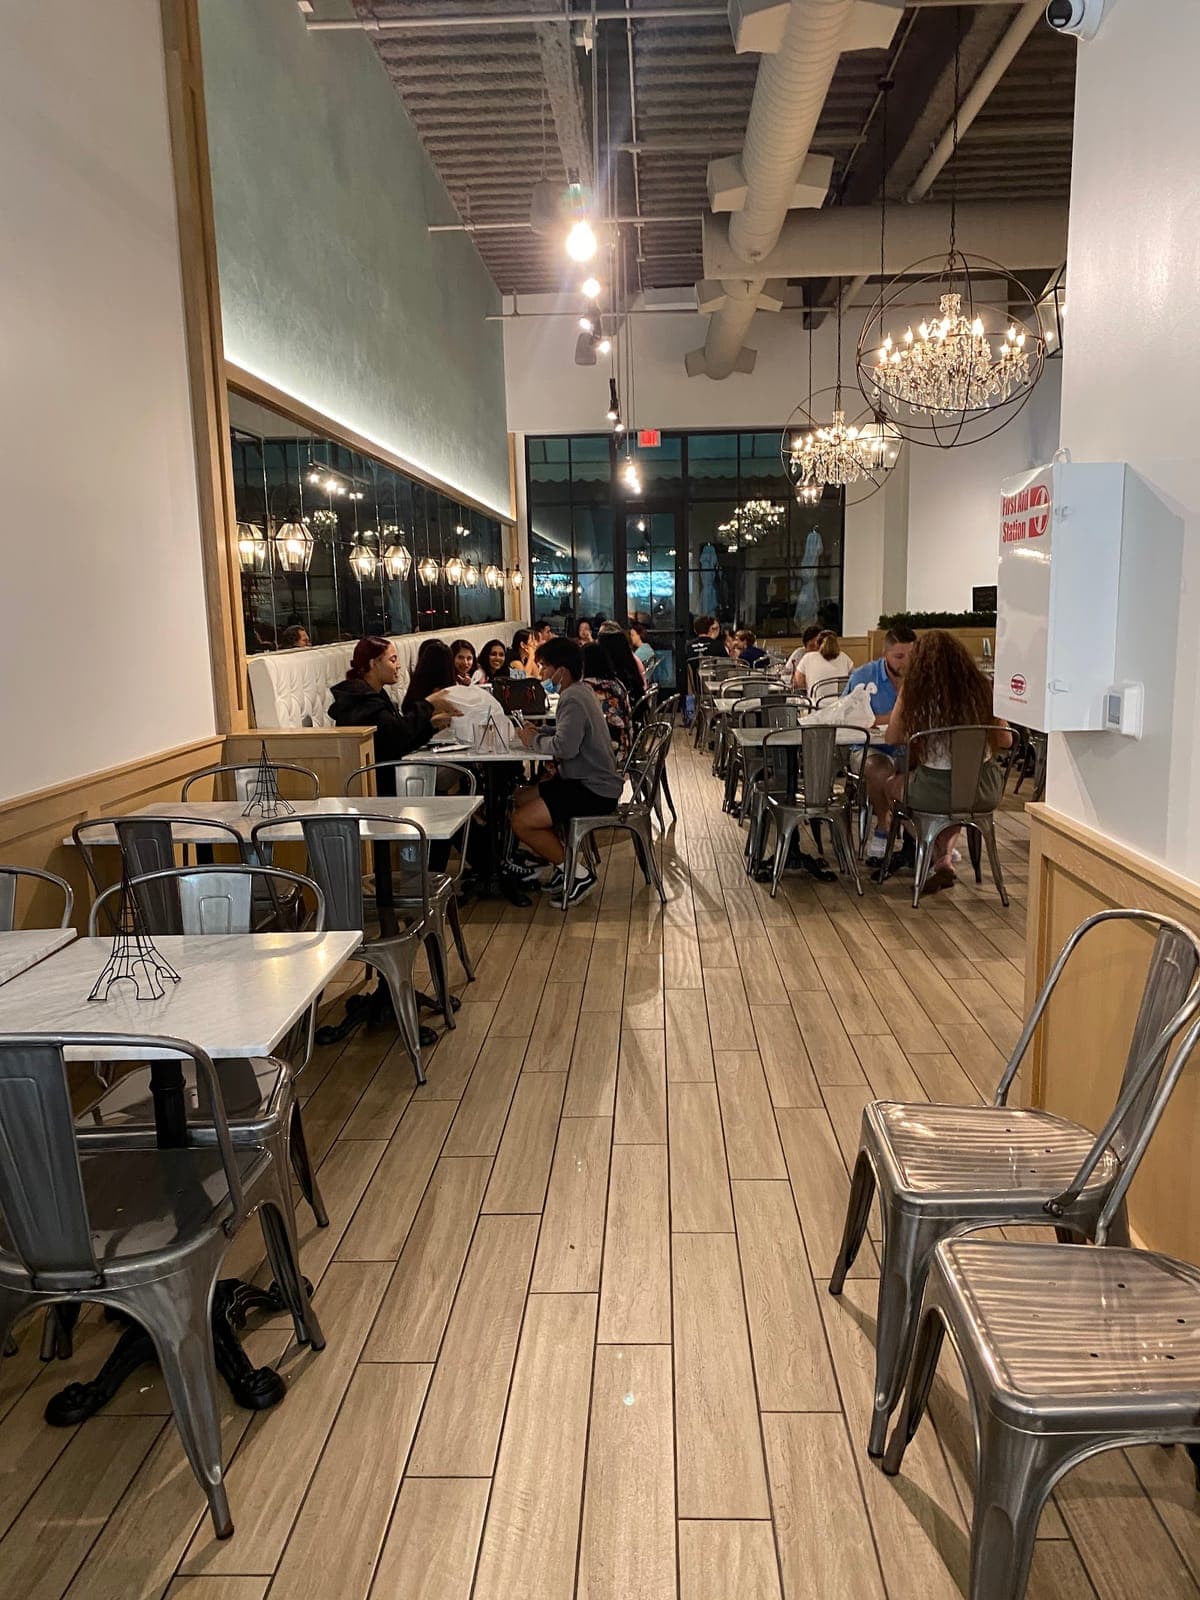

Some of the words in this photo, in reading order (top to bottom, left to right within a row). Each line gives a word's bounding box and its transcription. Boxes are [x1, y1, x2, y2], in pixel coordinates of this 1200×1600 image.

[1002, 494, 1017, 517] First
[1017, 489, 1029, 513] Aid
[1003, 520, 1026, 543] Station
